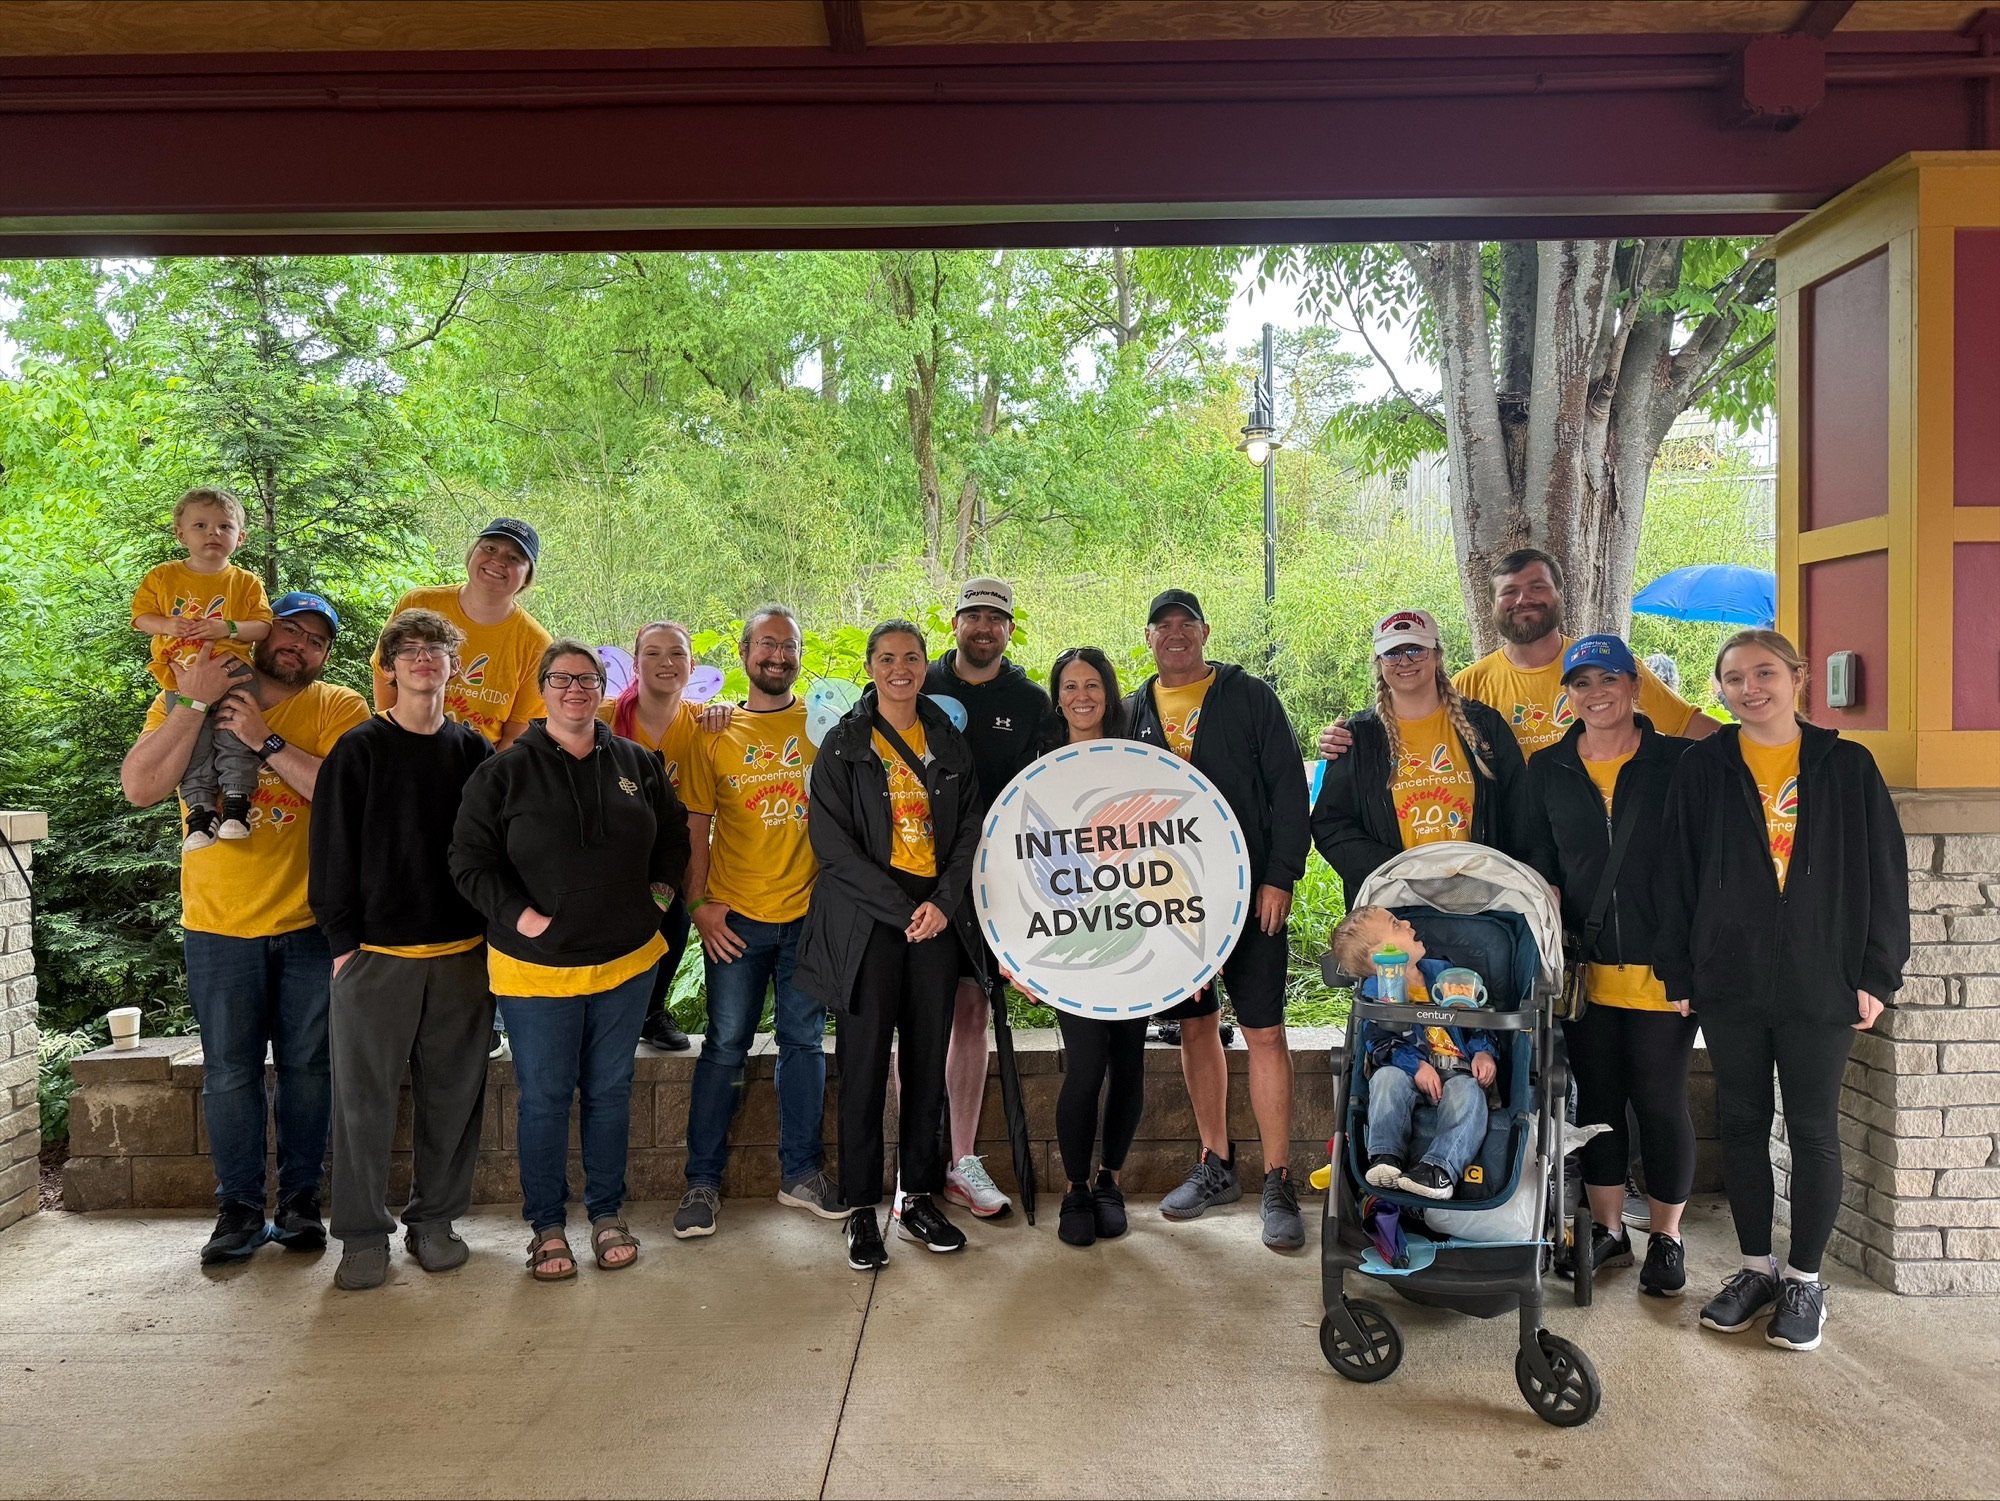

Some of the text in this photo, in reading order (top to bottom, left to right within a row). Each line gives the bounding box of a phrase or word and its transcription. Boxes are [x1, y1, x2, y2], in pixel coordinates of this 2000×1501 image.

[964, 589, 1008, 603] TaylorMade
[480, 687, 510, 705] KIDS
[740, 768, 802, 785] CancerFree
[1391, 774, 1457, 791] ancerFree
[744, 779, 799, 812] Butterfly
[759, 797, 789, 819] 20
[1410, 804, 1443, 828] 20
[762, 817, 787, 831] years
[1413, 826, 1441, 839] years
[1015, 816, 1202, 860] INTERLINK
[1049, 860, 1174, 896] CLOUD
[1026, 895, 1206, 939] ADVISORS
[1416, 1010, 1455, 1022] century
[1468, 1167, 1480, 1180] C
